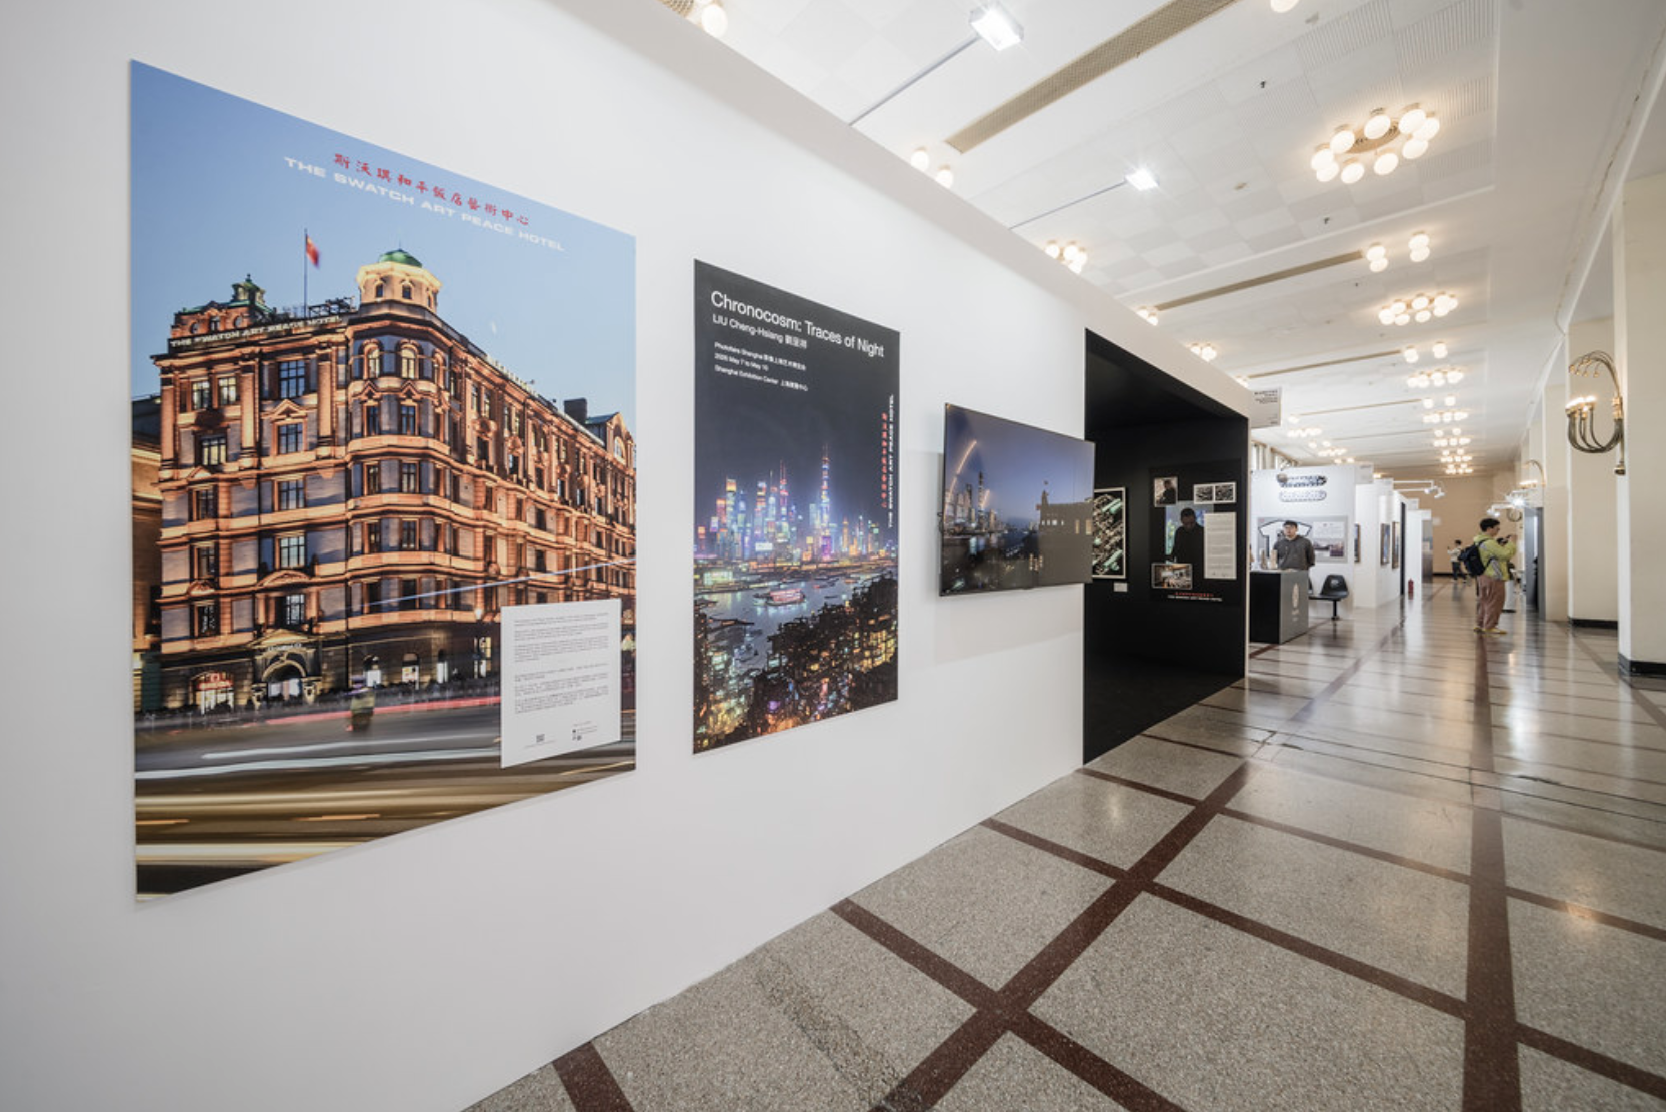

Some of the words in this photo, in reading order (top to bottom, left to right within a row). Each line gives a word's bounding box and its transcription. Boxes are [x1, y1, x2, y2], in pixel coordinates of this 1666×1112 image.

[284, 156, 327, 178] THE
[334, 172, 415, 205] SWATCH
[421, 200, 456, 218] ART
[462, 213, 514, 236] PEACE
[519, 231, 565, 252] HOTEL
[711, 290, 802, 332] Chronocosm:
[805, 321, 842, 345] Traces
[844, 336, 856, 348] of
[857, 338, 885, 358] Night
[712, 313, 728, 326] LIU
[729, 319, 784, 344] Cheng-Hsiang
